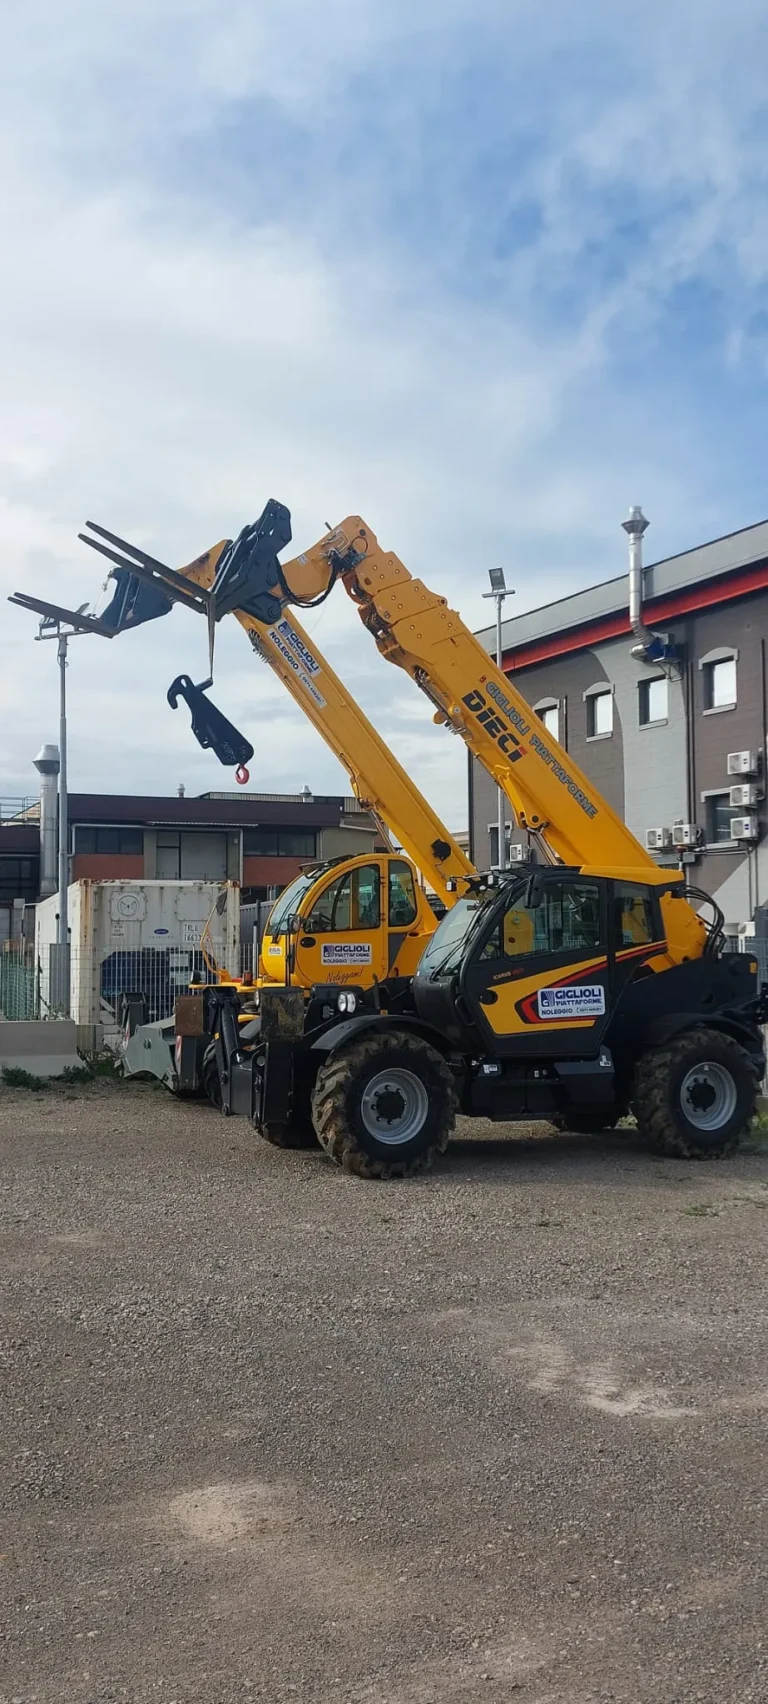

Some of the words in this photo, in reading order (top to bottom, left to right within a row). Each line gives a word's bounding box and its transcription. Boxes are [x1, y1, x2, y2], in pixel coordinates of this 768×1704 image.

[269, 631, 299, 670] NOLEGGIO
[290, 632, 319, 671] GIGLIOLI
[486, 681, 531, 736] GIGLIOLI
[528, 733, 598, 819] PIATTAFORME
[184, 924, 198, 932] TRLU
[555, 988, 602, 999] GIGLIOLI
[555, 998, 602, 1006] PIATTAFORME
[541, 1008, 573, 1016] NOLEGGIO
